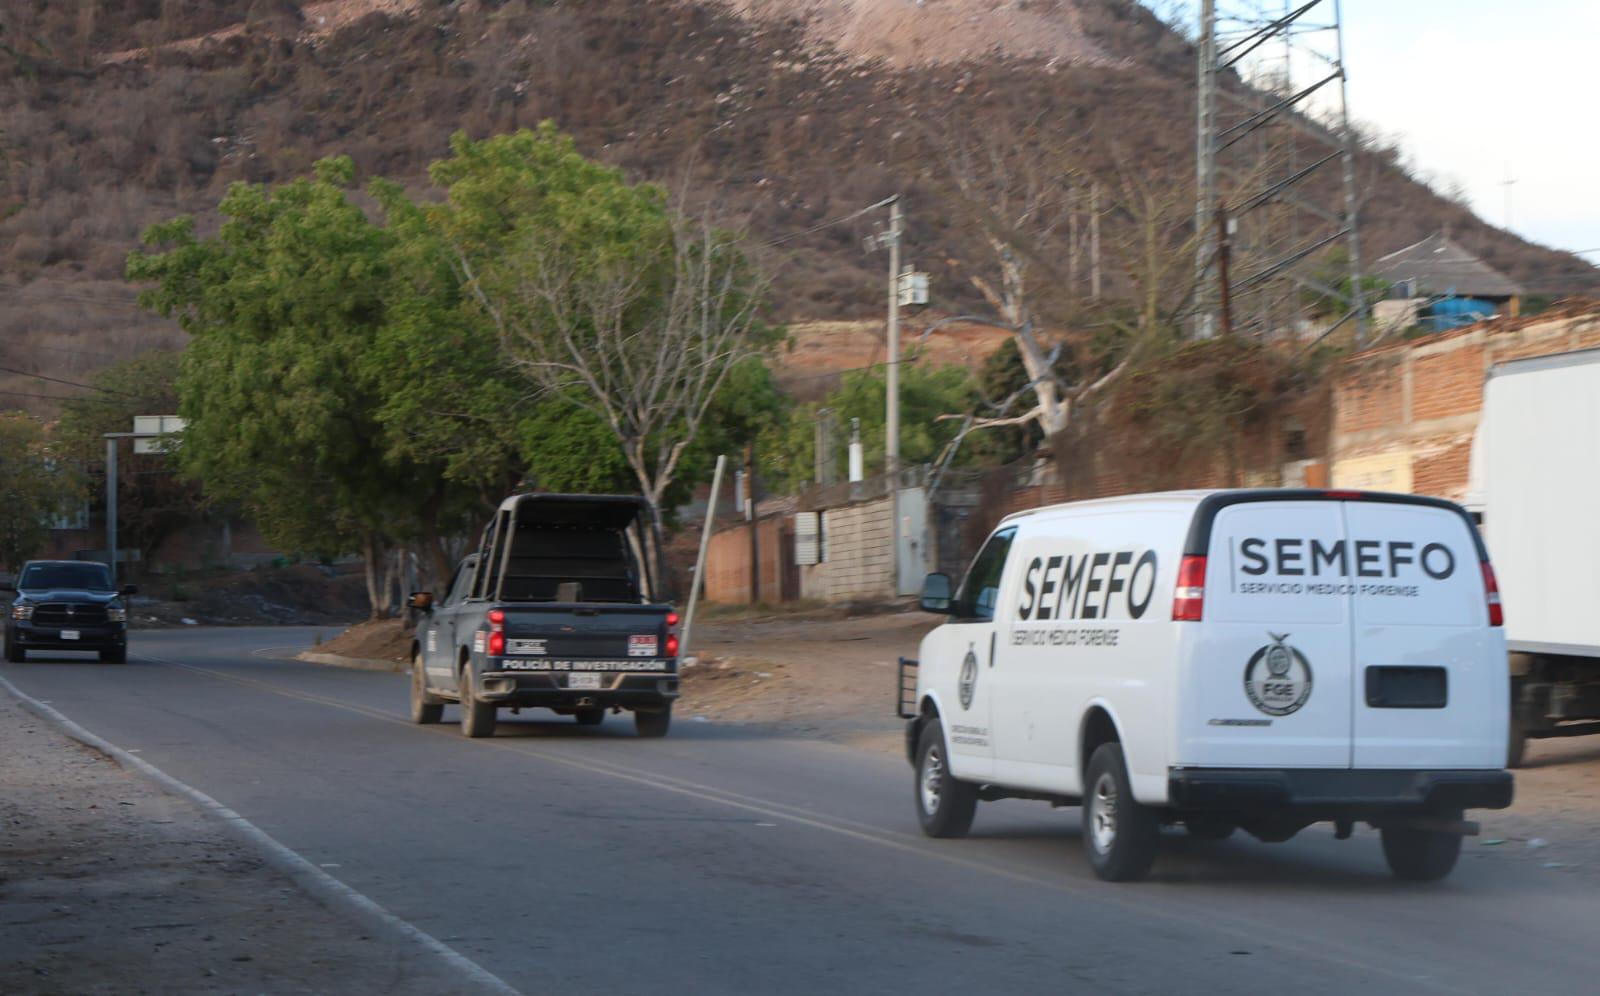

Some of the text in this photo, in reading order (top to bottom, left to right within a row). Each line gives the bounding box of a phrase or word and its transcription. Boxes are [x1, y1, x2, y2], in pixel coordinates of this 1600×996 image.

[1240, 537, 1455, 580] SEMEFO
[1019, 549, 1157, 621] SEMEFO
[1240, 583, 1419, 597] SERVICIO MEDICO FORENSE
[1013, 629, 1046, 645] SERVICIO
[1080, 629, 1119, 645] FORENSE
[502, 658, 666, 670] POLICÍA DE INVESTIGACIÓN
[1264, 683, 1294, 696] FGE
